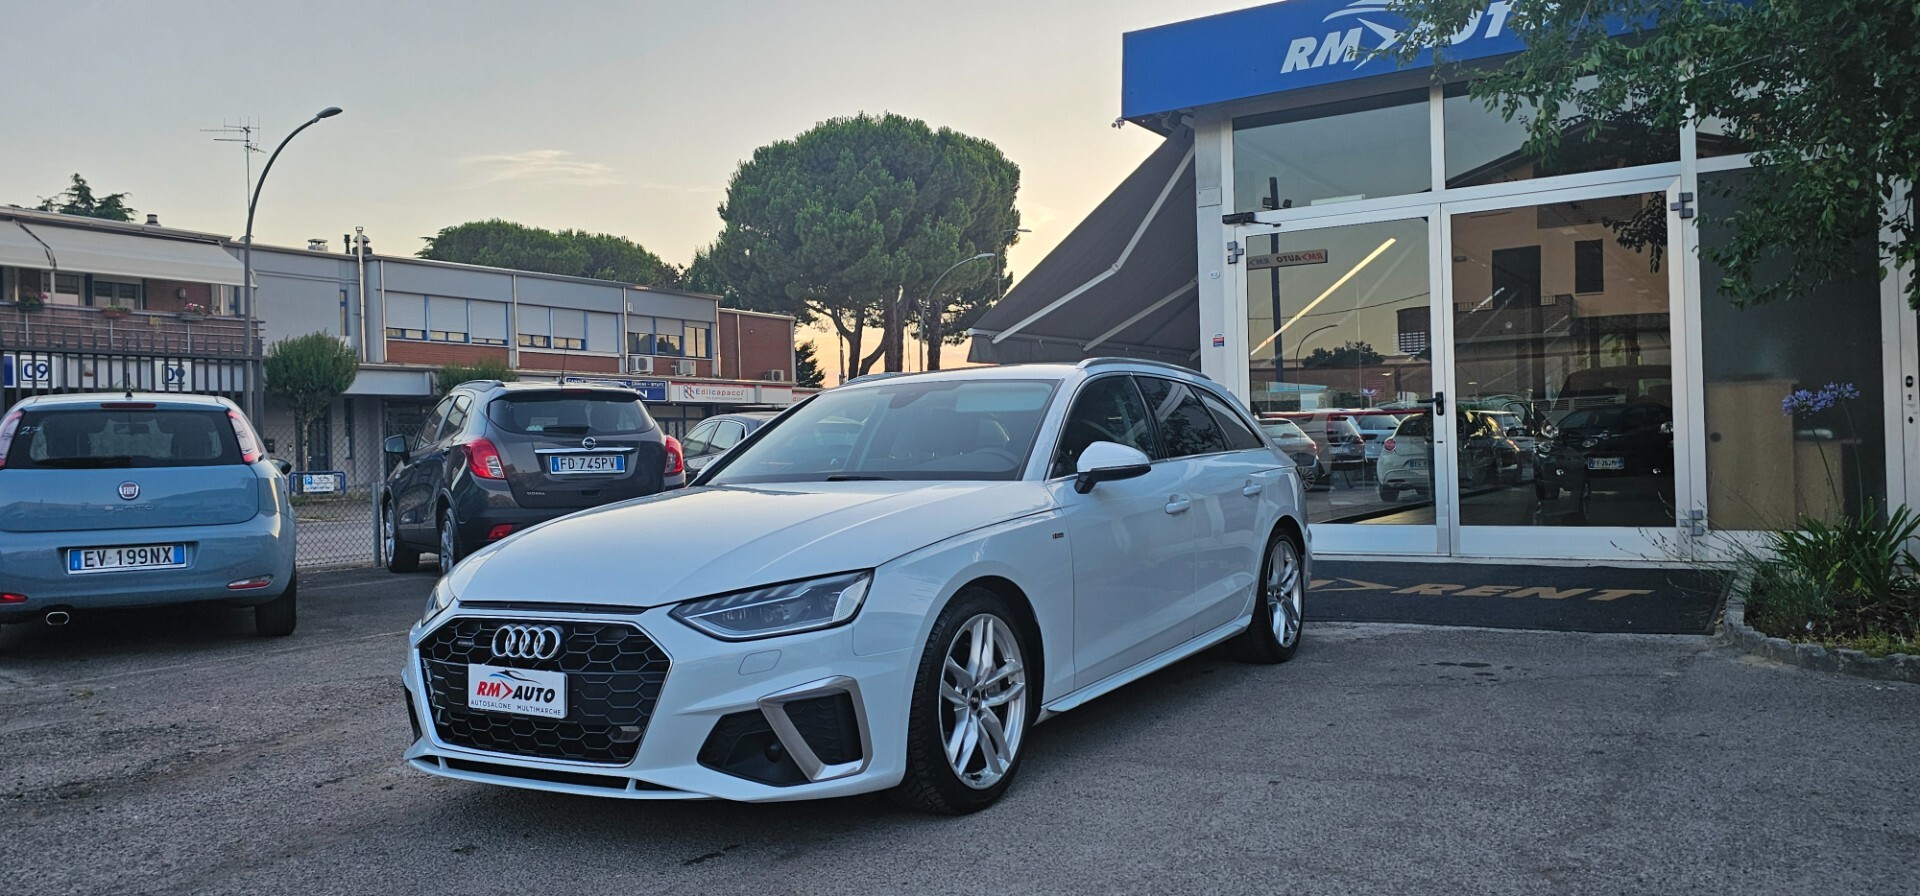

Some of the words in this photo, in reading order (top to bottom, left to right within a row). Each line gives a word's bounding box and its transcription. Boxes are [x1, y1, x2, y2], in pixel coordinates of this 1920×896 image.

[1280, 27, 1363, 74] RM
[560, 458, 575, 470] FD
[579, 457, 615, 470] 745PV
[84, 550, 106, 568] EV
[116, 546, 172, 566] 199NX
[1390, 583, 1656, 601] RENT
[476, 681, 501, 698] RM
[512, 685, 556, 703] AUTO
[470, 699, 512, 710] AUTOSALONE
[517, 705, 562, 716] MULTIMARCHE
